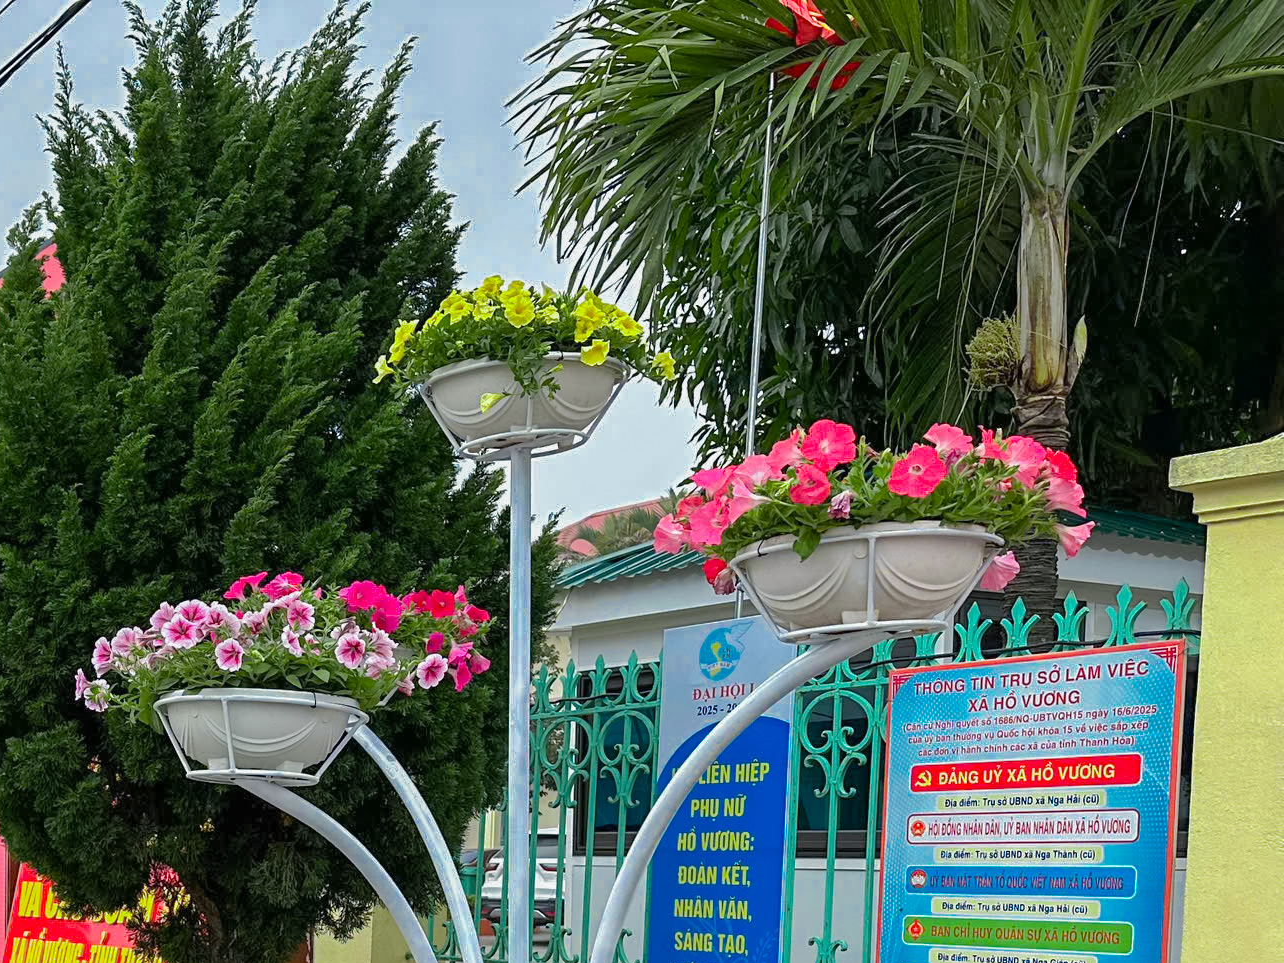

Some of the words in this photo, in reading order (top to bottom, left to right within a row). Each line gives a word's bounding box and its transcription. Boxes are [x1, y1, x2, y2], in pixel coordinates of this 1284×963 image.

[914, 678, 965, 695] THÔNG
[971, 676, 995, 691] TIN
[1000, 672, 1032, 689] TRỤ
[1037, 664, 1061, 685] SỞ
[1065, 663, 1101, 682] LÀM
[1108, 658, 1149, 679] VIỆC
[693, 687, 716, 702] ĐẠI
[720, 683, 745, 699] HỘI
[968, 696, 988, 713] XÃ
[993, 690, 1017, 711] HỒ
[1021, 690, 1080, 708] VƯƠNG
[697, 705, 718, 716] 2025
[735, 758, 770, 786] HIỆP
[938, 766, 979, 785] ĐẢNG
[983, 765, 1003, 783] UỶ
[1006, 765, 1027, 782] XÃ
[1031, 761, 1054, 782] HỒ
[1058, 763, 1115, 780] VƯƠNG
[690, 798, 720, 822] PHỤ
[723, 793, 747, 817] NỮ
[982, 797, 996, 808] Trụ
[1009, 796, 1033, 806] UBND
[1035, 795, 1045, 805] xã
[1047, 796, 1064, 806] Nga
[1082, 793, 1100, 805] (cũ)
[676, 826, 696, 852] HỒ
[701, 830, 755, 852] VƯƠNG:
[1016, 822, 1031, 835] BAN
[975, 850, 988, 860] Trụ
[1000, 850, 1022, 859] UBND
[1035, 850, 1051, 860] Nga
[1080, 849, 1096, 860] (cũ)
[677, 861, 717, 886] ĐOÀN
[722, 859, 751, 888] KẾT,
[673, 895, 714, 919] NHÂN
[718, 895, 752, 922] VĂN,
[977, 903, 990, 912] Trụ
[1002, 903, 1025, 912] UBND
[1038, 904, 1054, 914] Nga
[1071, 905, 1088, 915] (cũ)
[674, 928, 713, 953] SÁNG
[718, 933, 749, 958] TẠO,
[931, 925, 951, 937] BAN
[953, 922, 971, 937] CHỈ
[972, 927, 993, 939] HUY
[995, 924, 1024, 940] QUÂN
[1027, 928, 1042, 944] SỰ
[1044, 927, 1059, 942] XÃ
[1062, 925, 1078, 943] HỒ
[1081, 930, 1120, 945] VƯƠNG
[972, 954, 985, 963] Trụ
